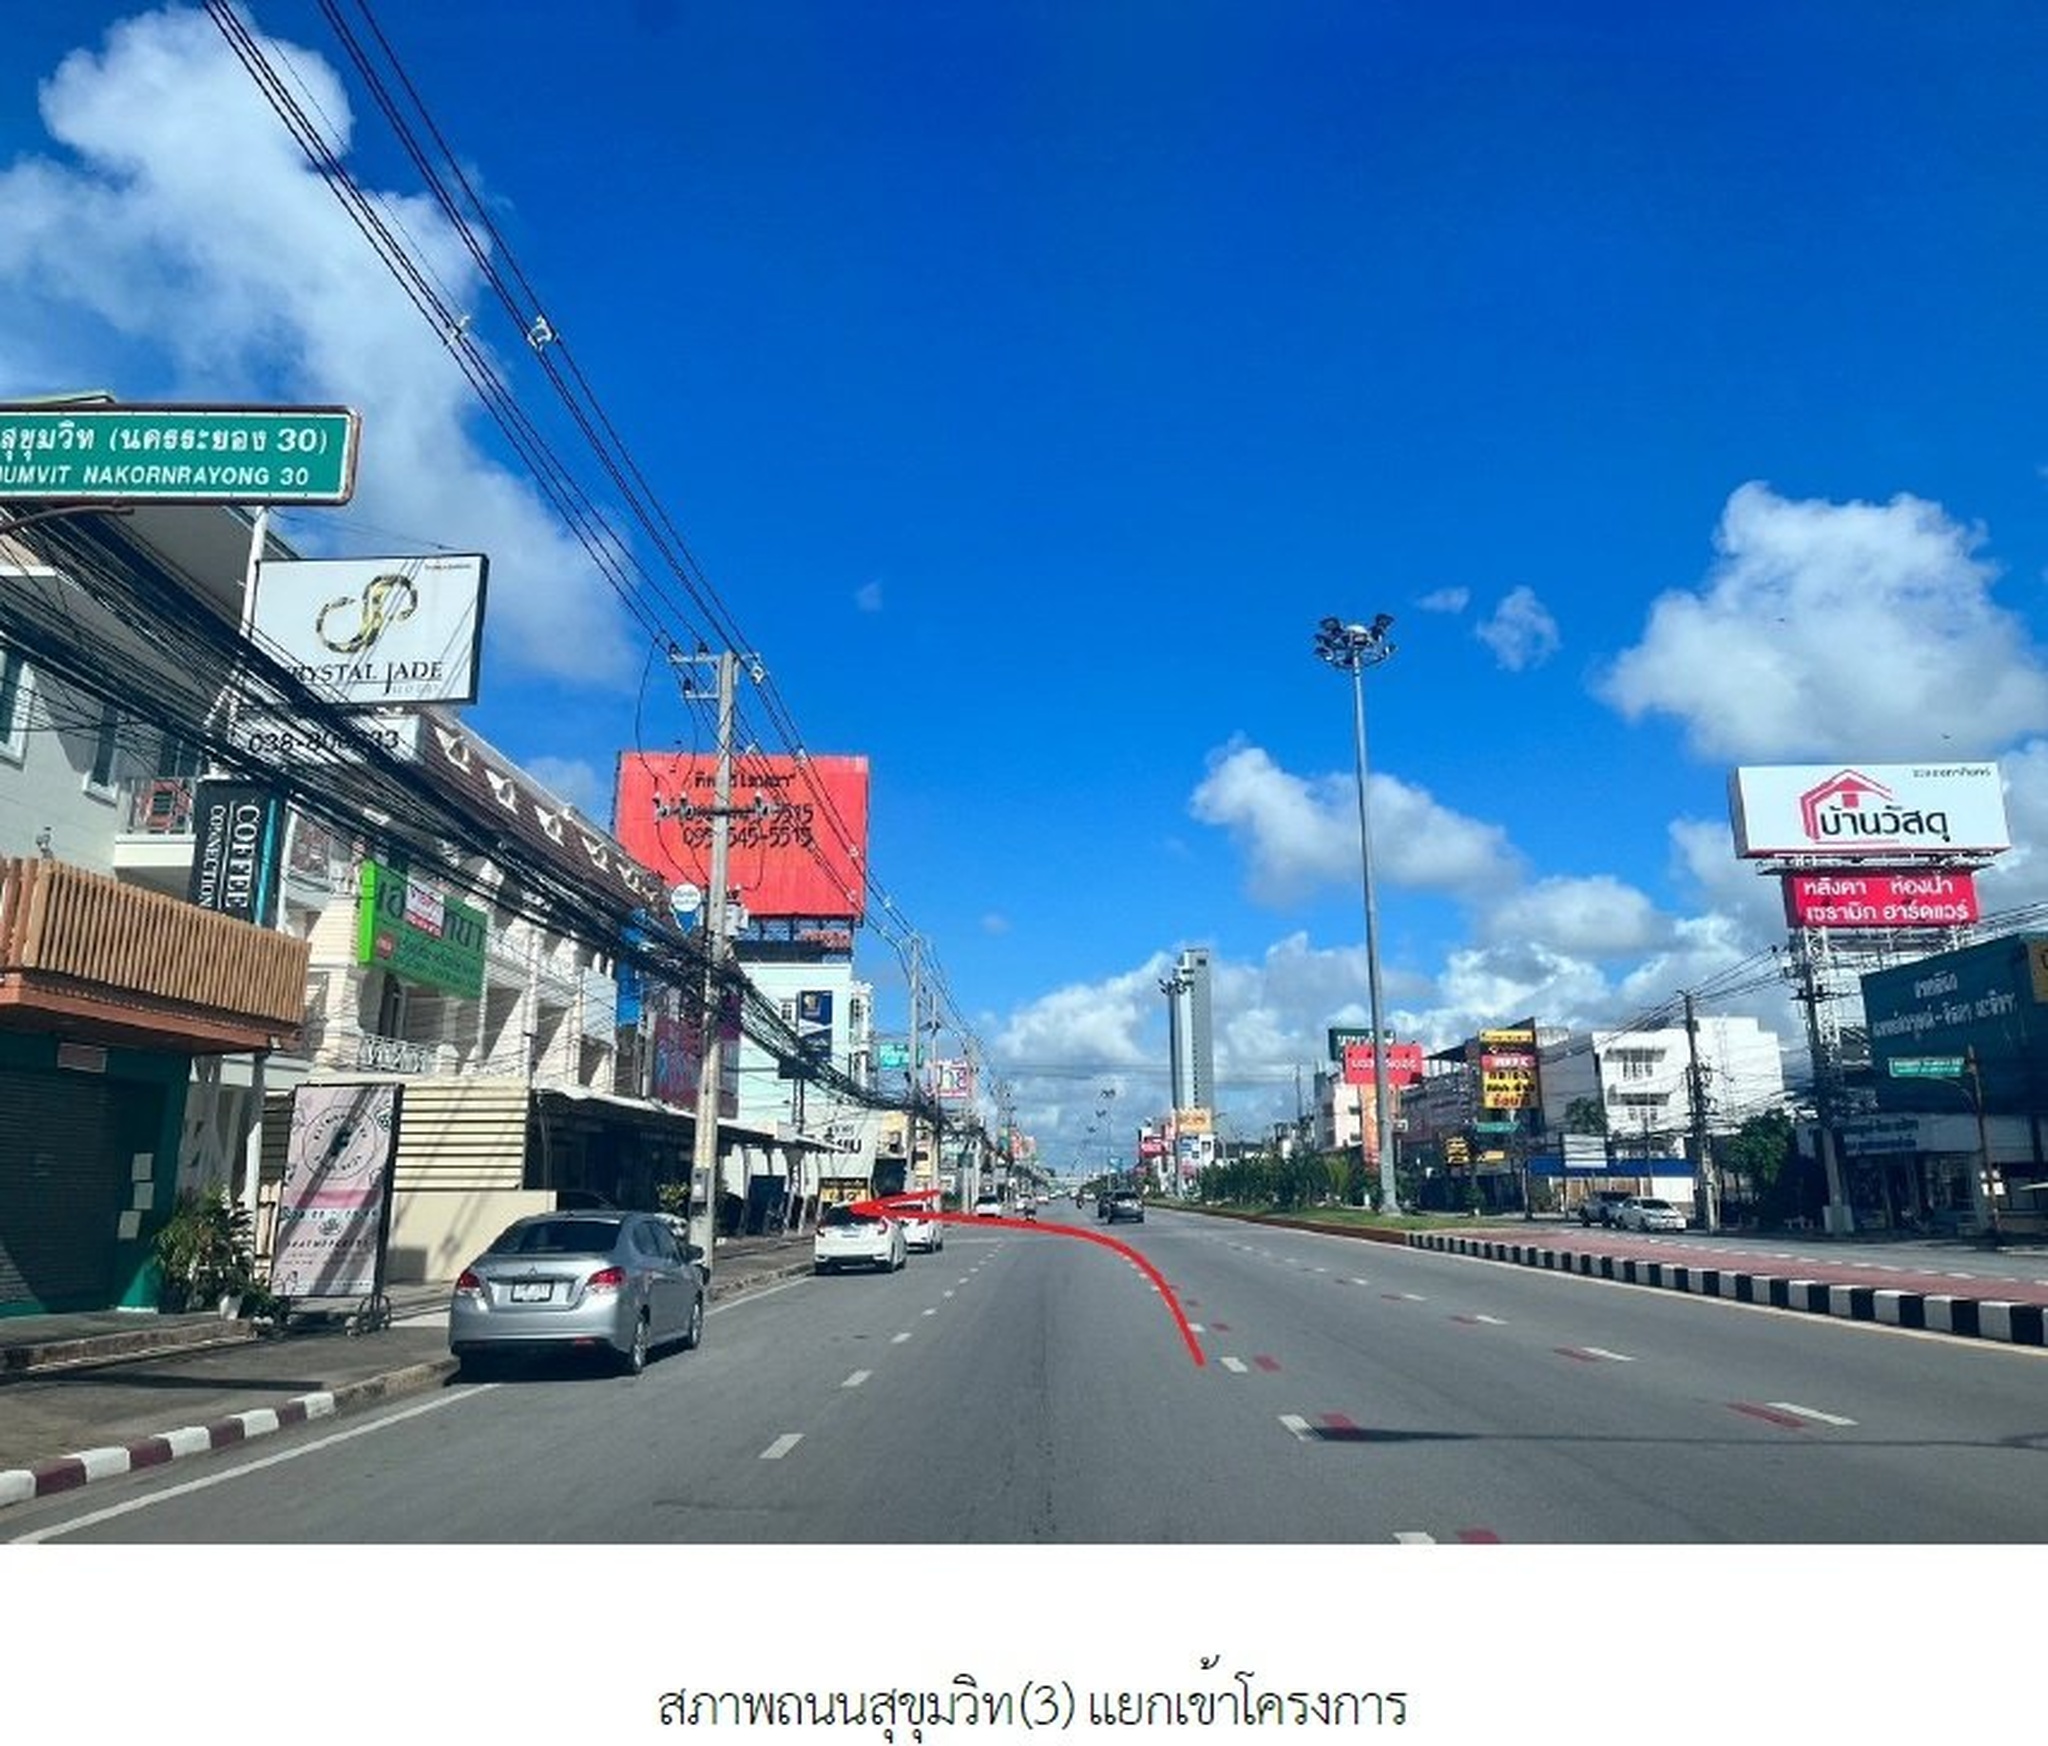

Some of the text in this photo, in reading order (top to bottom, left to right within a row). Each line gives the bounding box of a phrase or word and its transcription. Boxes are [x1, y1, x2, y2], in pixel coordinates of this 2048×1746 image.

[277, 428, 327, 454] 30)
[83, 465, 269, 486] NAKORNRAYONG
[280, 467, 309, 486] 30
[384, 660, 443, 695] JADE
[1820, 803, 1951, 843] บ้านวัสดุ
[225, 804, 260, 908] COFFEE
